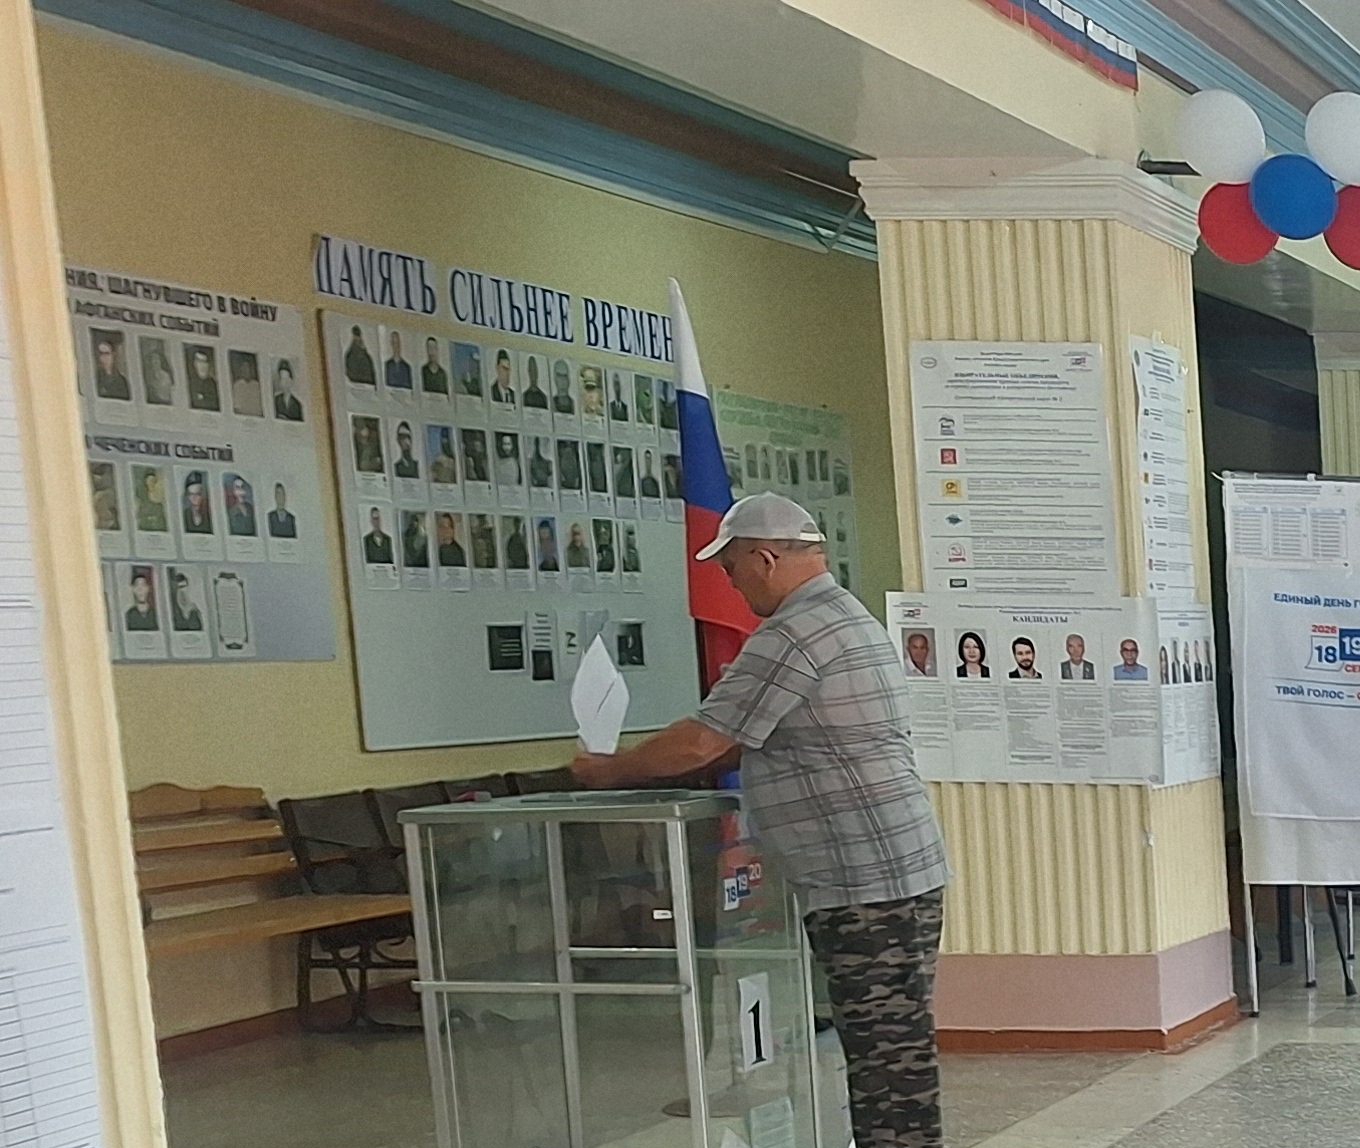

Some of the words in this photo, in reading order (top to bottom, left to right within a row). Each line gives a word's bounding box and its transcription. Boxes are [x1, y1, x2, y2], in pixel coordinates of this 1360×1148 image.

[316, 236, 436, 315] ПАМЯТЬ
[451, 269, 574, 344] СИЛЬНЕЕ
[231, 296, 278, 322] ВОЙНУ
[1274, 592, 1321, 606] ЕДИНЫЙ
[1323, 598, 1351, 608] ДЕНЬ
[1314, 645, 1337, 664] 18
[1275, 685, 1305, 697] ТВОЙ
[1307, 689, 1344, 700] ГОЛОС
[748, 999, 767, 1065] 1
